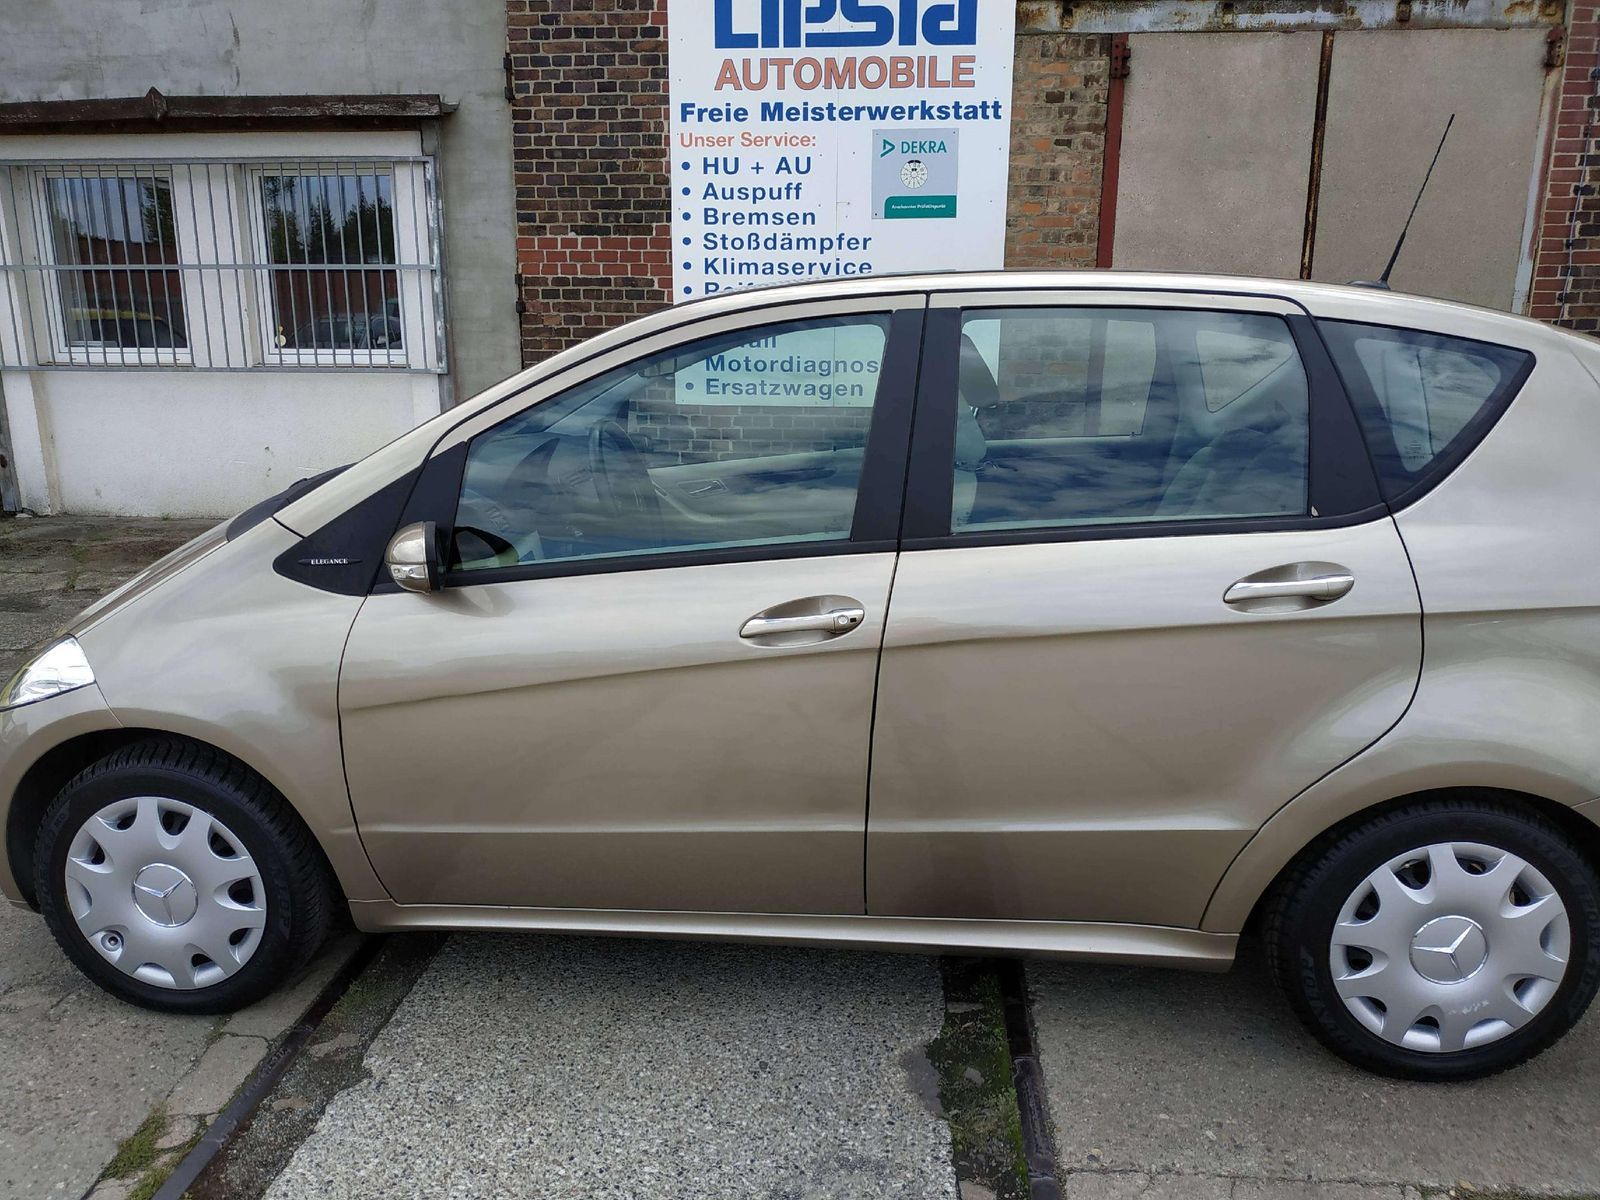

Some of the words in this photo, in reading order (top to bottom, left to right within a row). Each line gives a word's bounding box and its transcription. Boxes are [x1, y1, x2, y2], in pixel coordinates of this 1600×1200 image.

[714, 55, 977, 91] AUTOMOBILE
[680, 102, 749, 123] Freie
[760, 100, 1003, 122] Meisterwerkstatt
[680, 132, 735, 148] Unser
[740, 131, 817, 148] Service:
[901, 140, 947, 154] DEKRA
[702, 157, 740, 175] HU
[775, 156, 812, 175] AU
[702, 182, 803, 205] Auspuff
[703, 207, 816, 226] Bremsen
[702, 232, 872, 255] Stoßdämpfer
[704, 257, 873, 276] Klimaservice
[705, 354, 880, 377] Motordiagnos
[705, 378, 864, 401] Ersatzwagen
